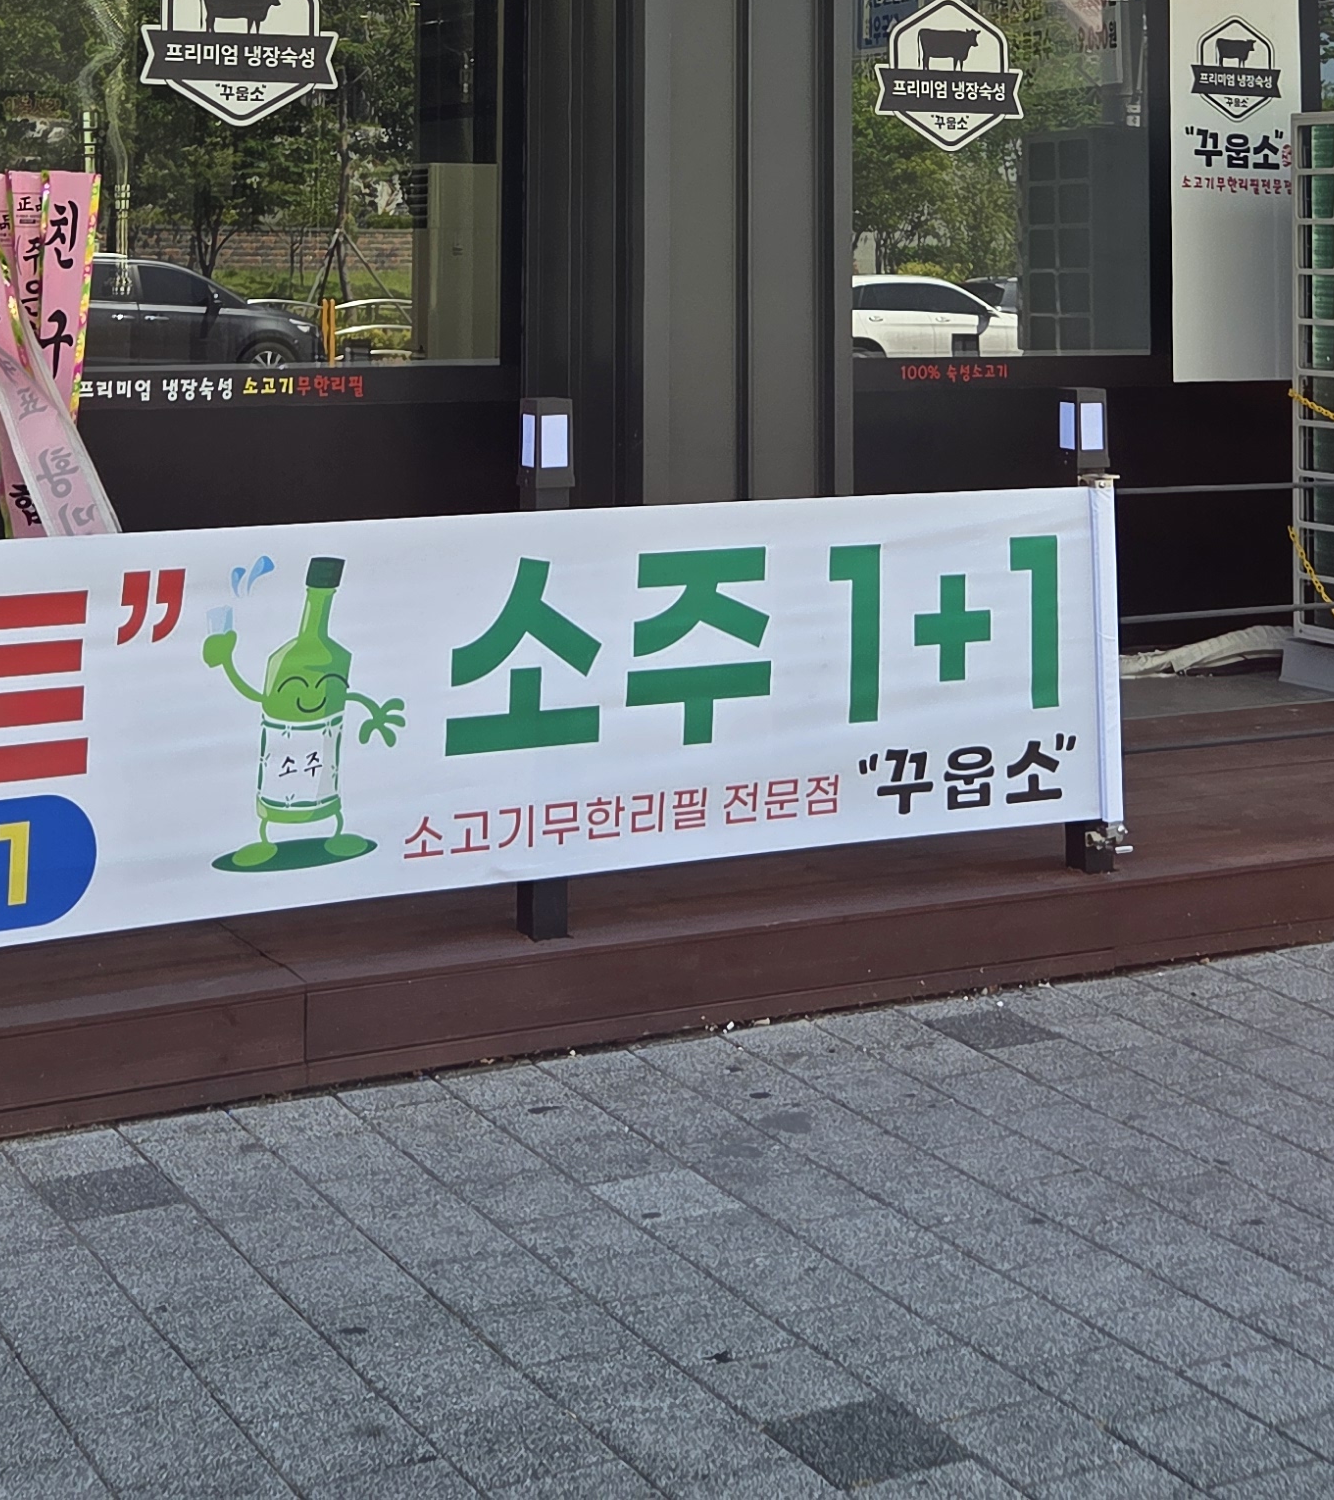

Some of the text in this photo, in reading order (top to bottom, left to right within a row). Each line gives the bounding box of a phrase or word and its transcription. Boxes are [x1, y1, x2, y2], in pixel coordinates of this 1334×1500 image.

[165, 44, 315, 68] 프리미엄 냉장숙성
[892, 81, 1006, 101] 프리미엄 냉장숙성
[1199, 73, 1273, 89] 프리미엄 냉장숙성
[900, 365, 1008, 383] 100% 숙성소고기
[78, 380, 151, 401] 프리미엄
[162, 377, 233, 402] 냉장숙성
[445, 535, 1060, 757] 소주 1+1
[278, 752, 324, 780] 소주
[403, 788, 708, 861] 소고기무한리필
[723, 775, 841, 825] 전문점
